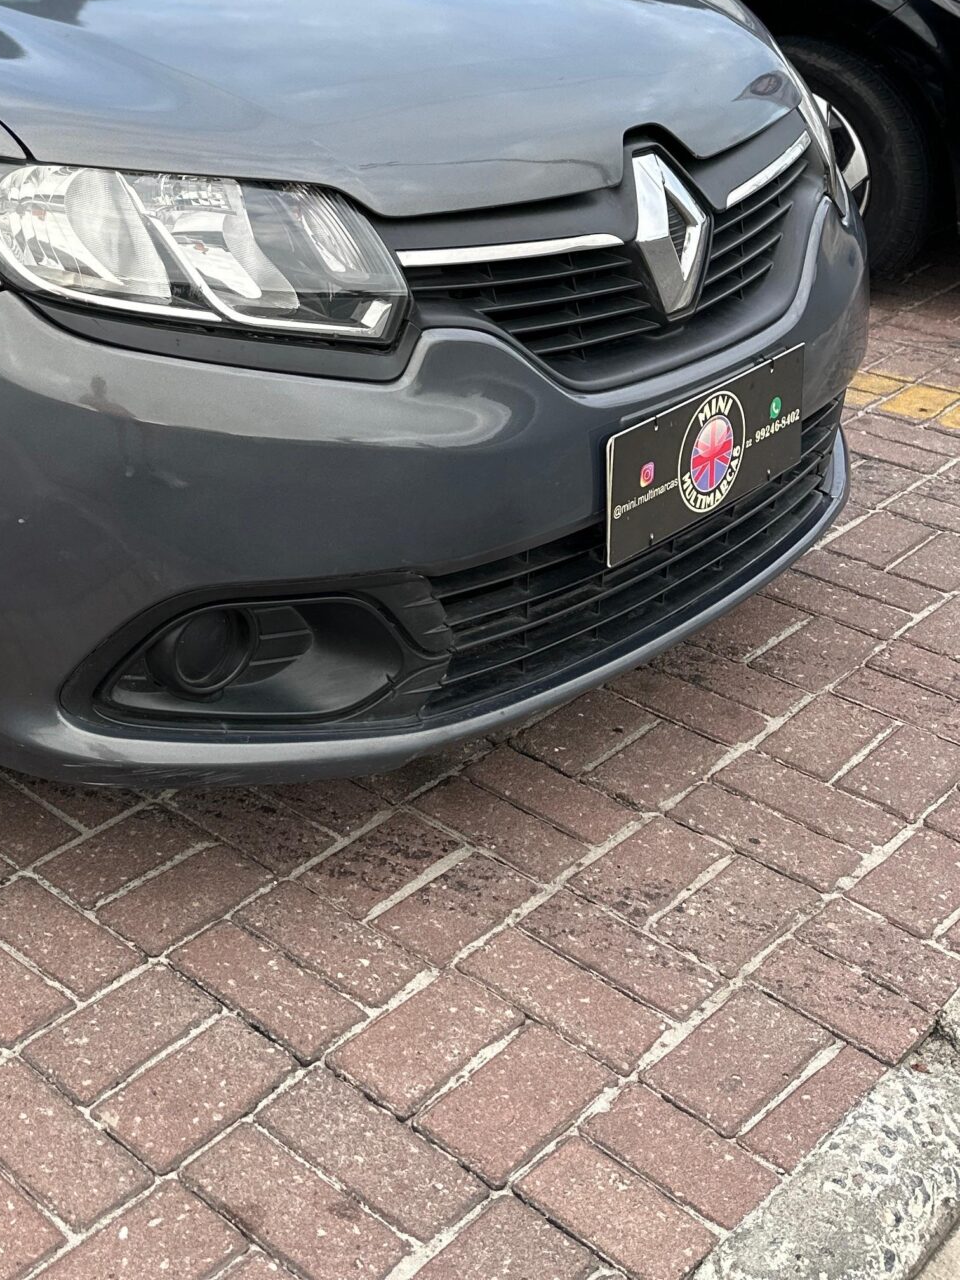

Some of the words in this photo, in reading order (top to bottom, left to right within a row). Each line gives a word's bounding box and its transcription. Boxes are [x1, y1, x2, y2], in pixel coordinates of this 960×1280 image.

[698, 395, 733, 427] MINI
[755, 408, 800, 443] 99246-8402
[681, 445, 740, 509] MULTIMARCAS
[613, 478, 678, 519] @mini.multimarcas
